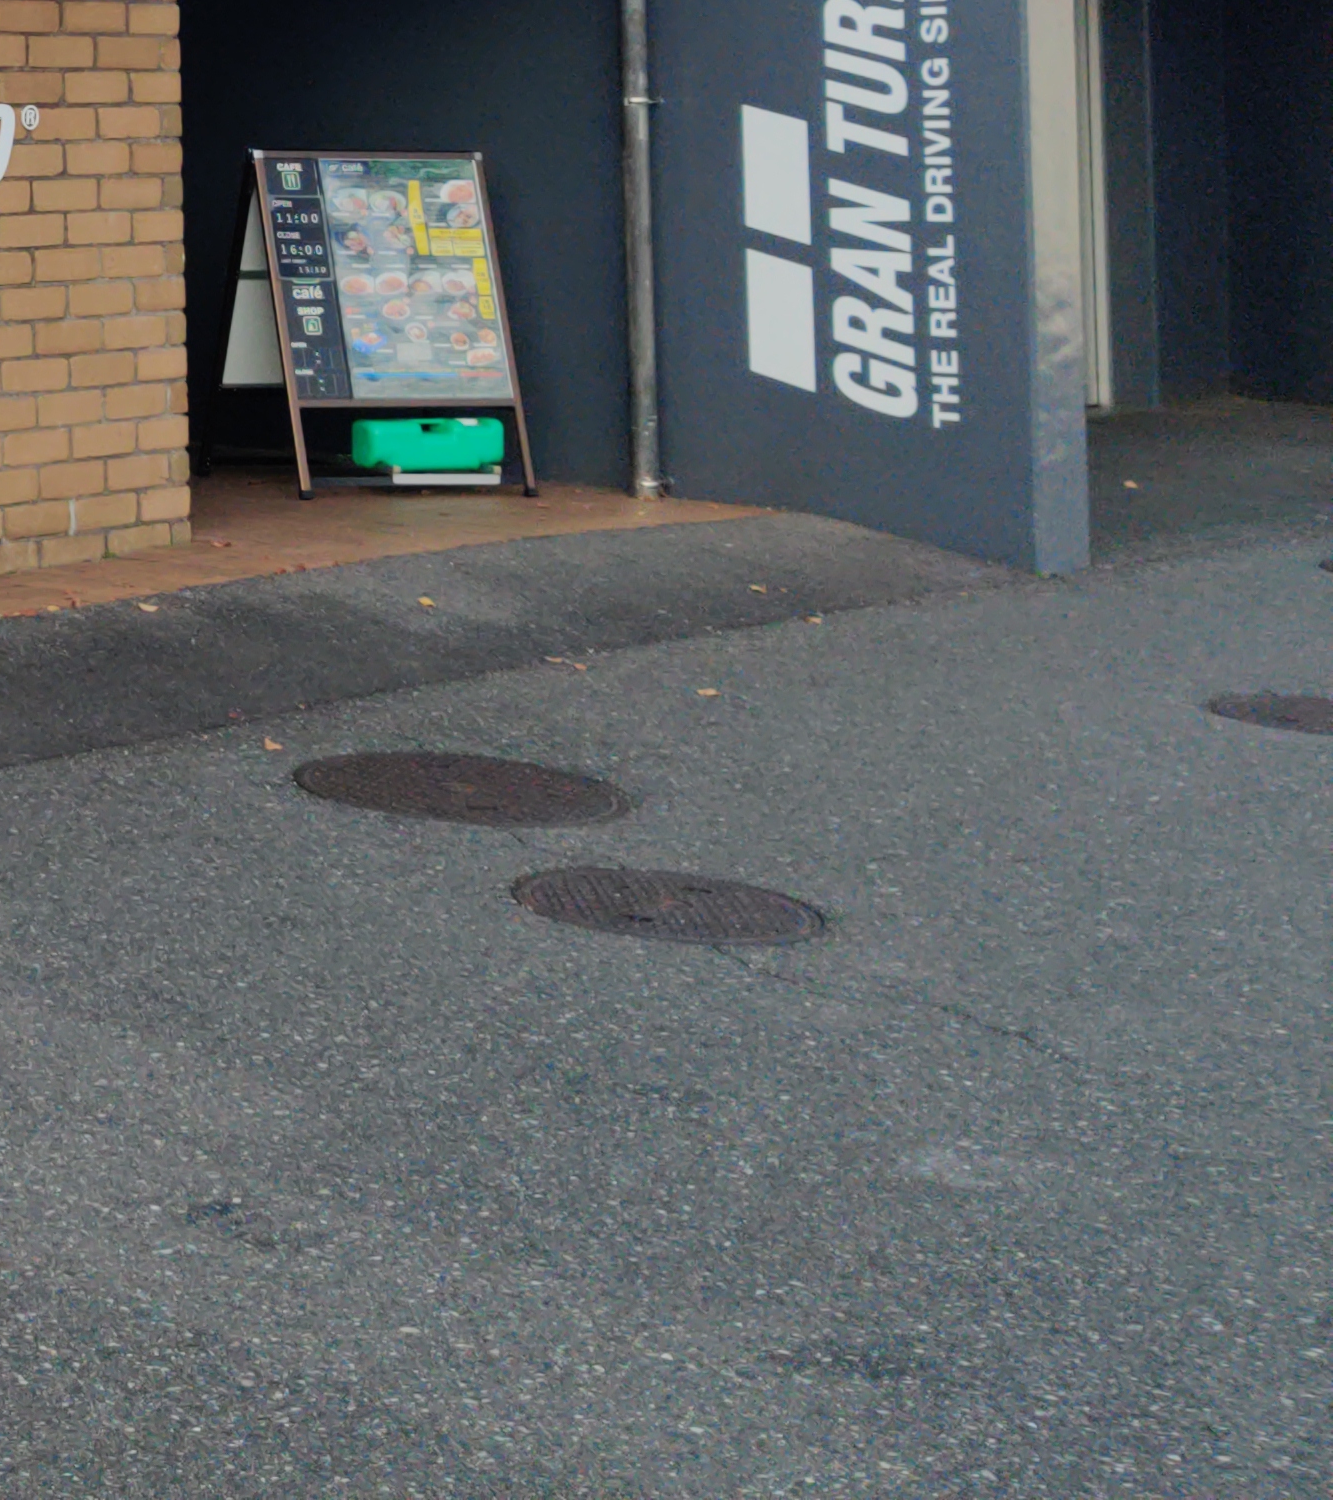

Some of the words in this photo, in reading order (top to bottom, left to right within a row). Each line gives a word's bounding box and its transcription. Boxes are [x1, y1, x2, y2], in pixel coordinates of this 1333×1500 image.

[920, 57, 954, 223] DRIVING
[276, 213, 319, 223] 11:00
[281, 244, 323, 255] 16:00
[827, 178, 920, 419] GRAN
[925, 234, 958, 338] REAL
[933, 348, 961, 429] THE
